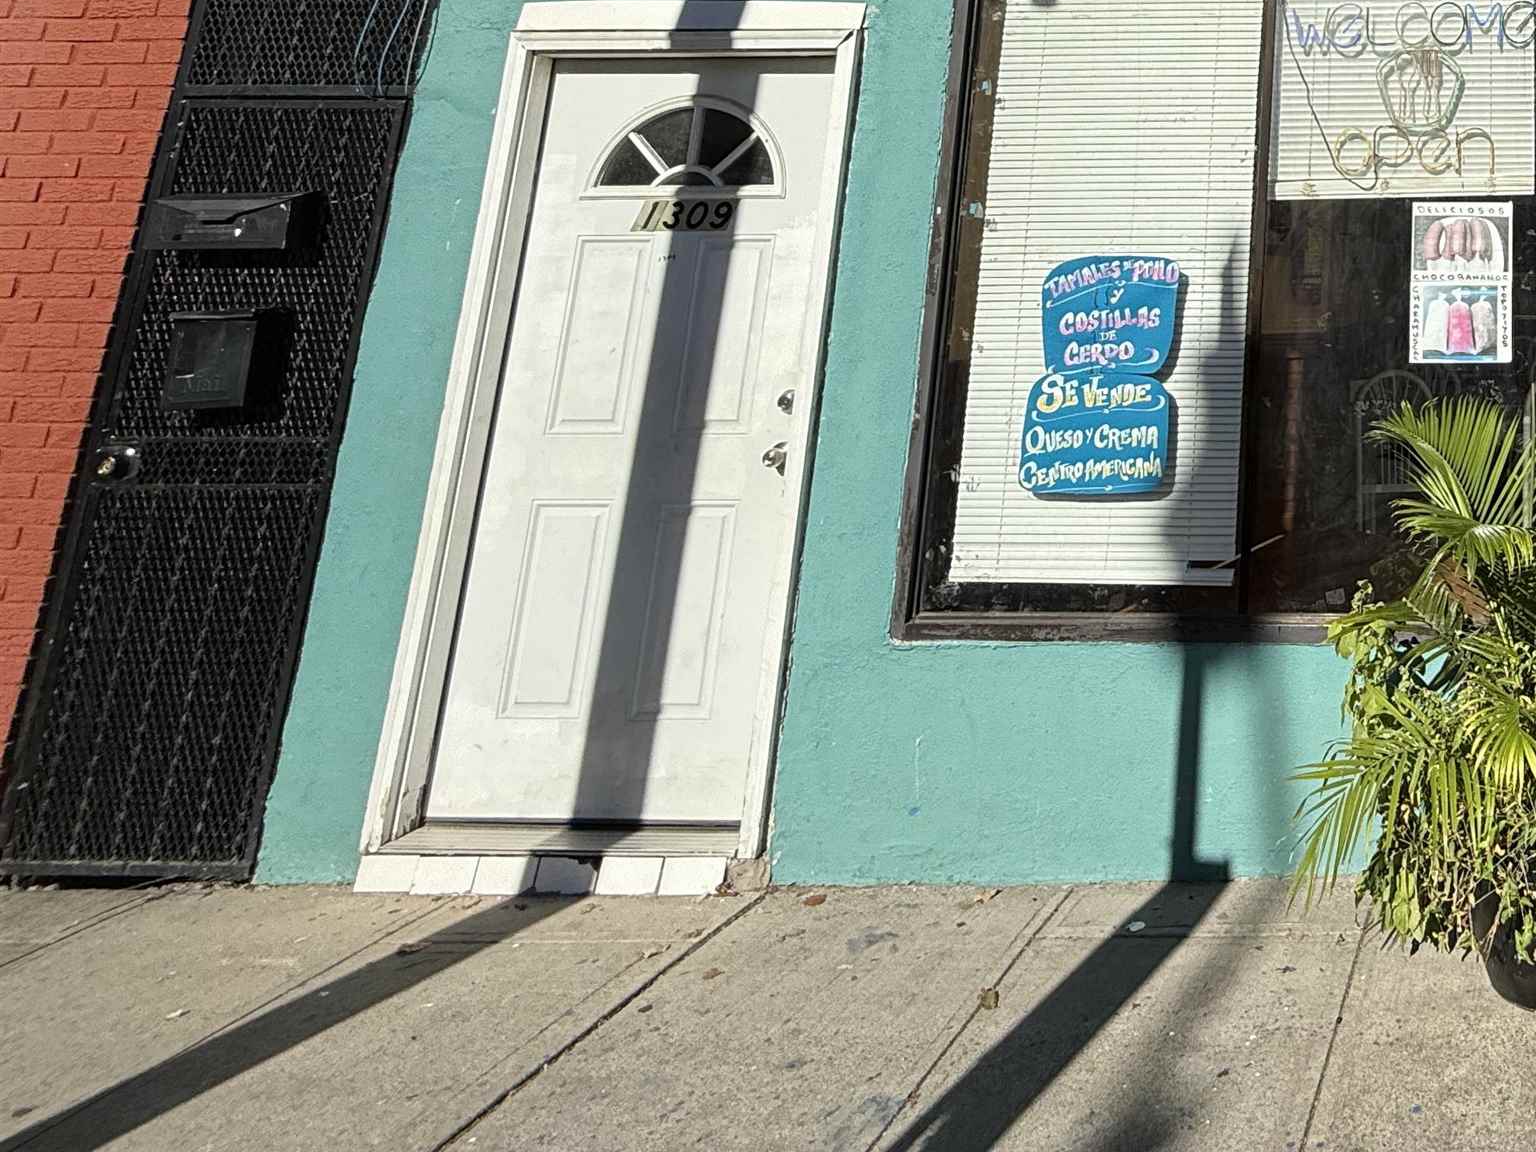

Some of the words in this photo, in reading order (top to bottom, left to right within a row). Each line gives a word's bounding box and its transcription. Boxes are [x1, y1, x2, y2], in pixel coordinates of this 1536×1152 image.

[1289, 1, 1536, 54] WELCOME
[641, 201, 733, 230] 1309
[1044, 260, 1121, 298] TAMALES
[1059, 306, 1160, 335] COSTILLAS
[1099, 330, 1117, 341] DE
[1064, 341, 1135, 366] CERDO
[1036, 374, 1079, 413] SE
[1080, 375, 1151, 409] VENDE
[1024, 425, 1084, 457] QUESO
[1094, 424, 1159, 451] CREMA
